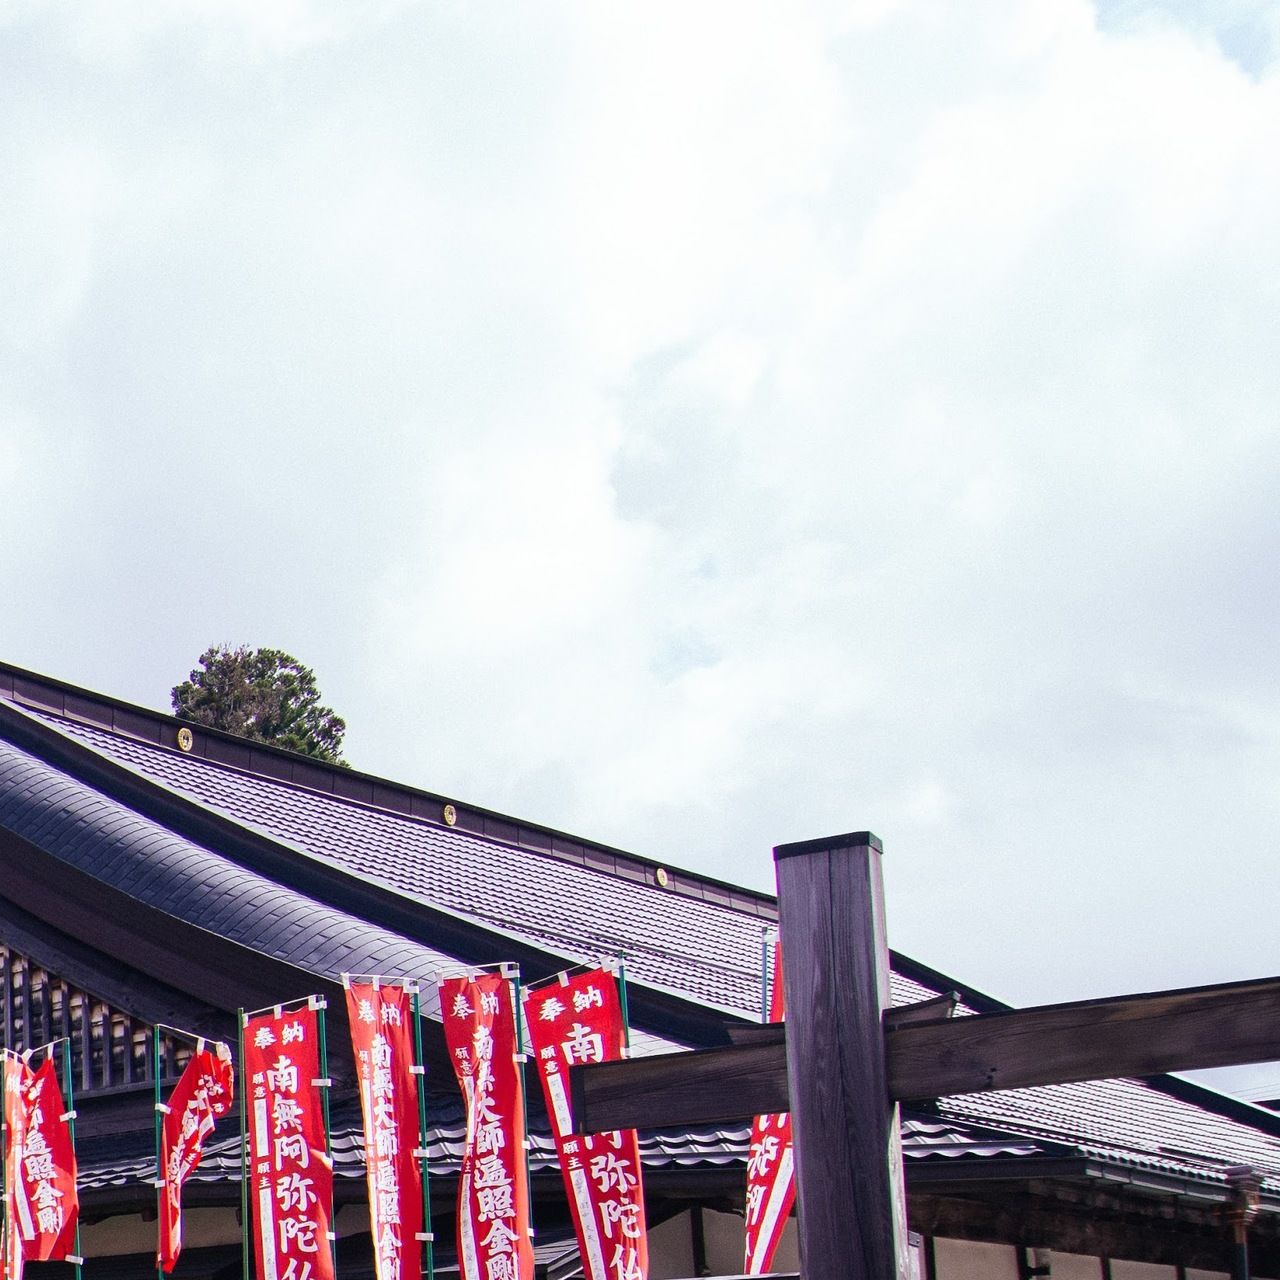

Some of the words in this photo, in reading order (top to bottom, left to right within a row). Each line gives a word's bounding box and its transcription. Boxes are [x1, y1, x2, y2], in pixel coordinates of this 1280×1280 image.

[357, 999, 401, 1026] 奉納
[450, 993, 500, 1020] 奉納
[539, 985, 604, 1022] 奉納
[254, 1020, 305, 1050] 奉納
[455, 1046, 473, 1076] 願意
[540, 1045, 559, 1075] 願意
[252, 1071, 266, 1098] 願意
[563, 1140, 583, 1170] 願主
[257, 1161, 272, 1189] 願主
